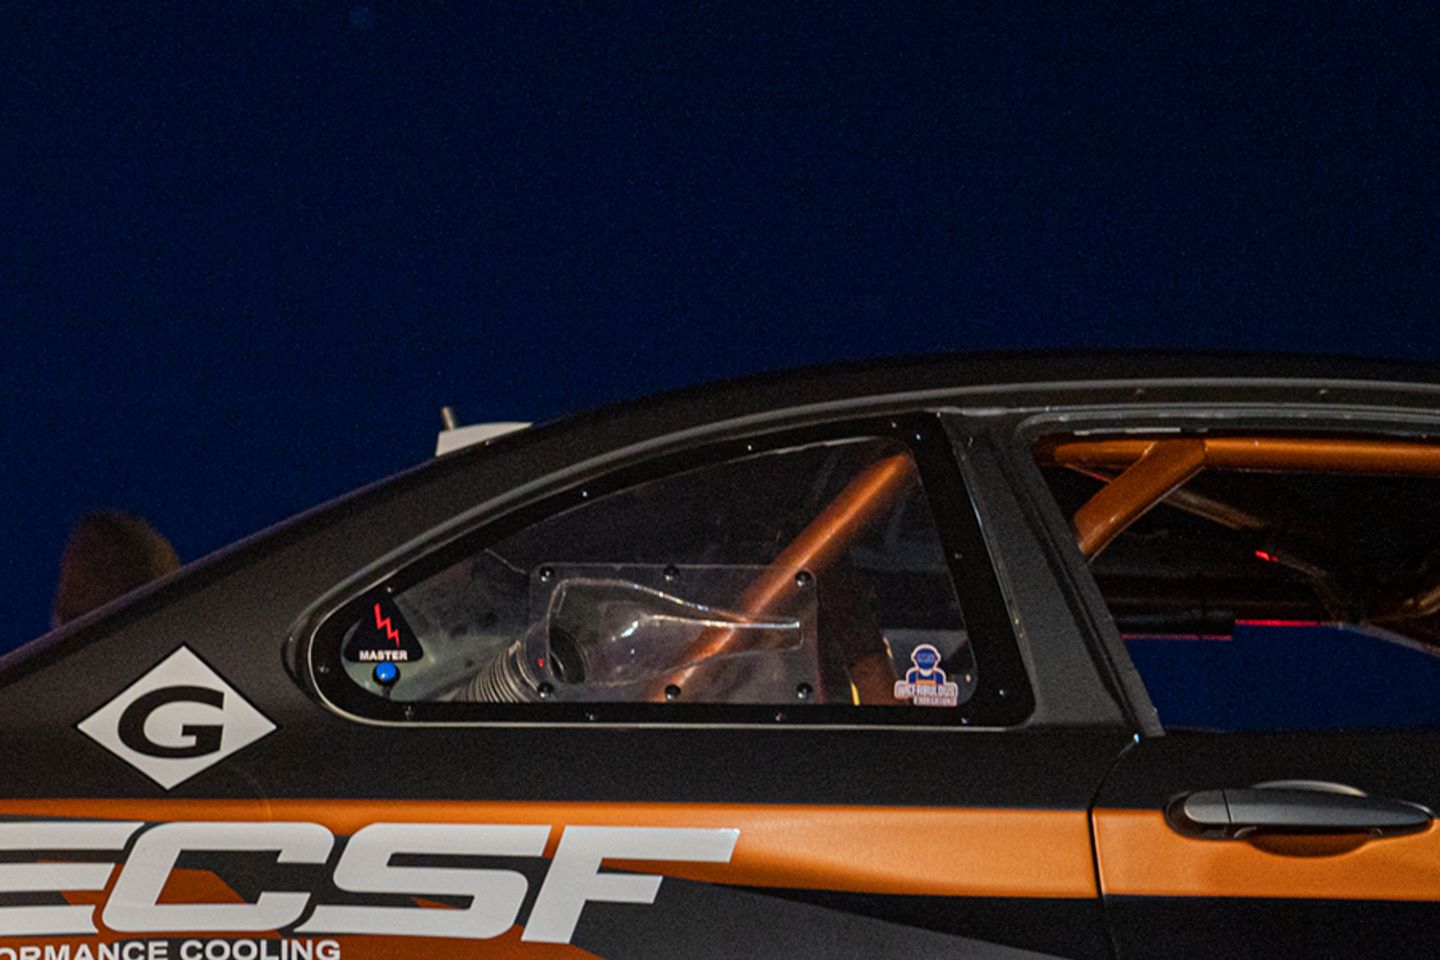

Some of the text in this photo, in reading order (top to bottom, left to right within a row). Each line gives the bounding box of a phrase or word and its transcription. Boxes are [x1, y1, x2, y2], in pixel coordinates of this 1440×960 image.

[359, 649, 408, 661] MASTER
[117, 685, 225, 760] G
[101, 820, 742, 945] CSF
